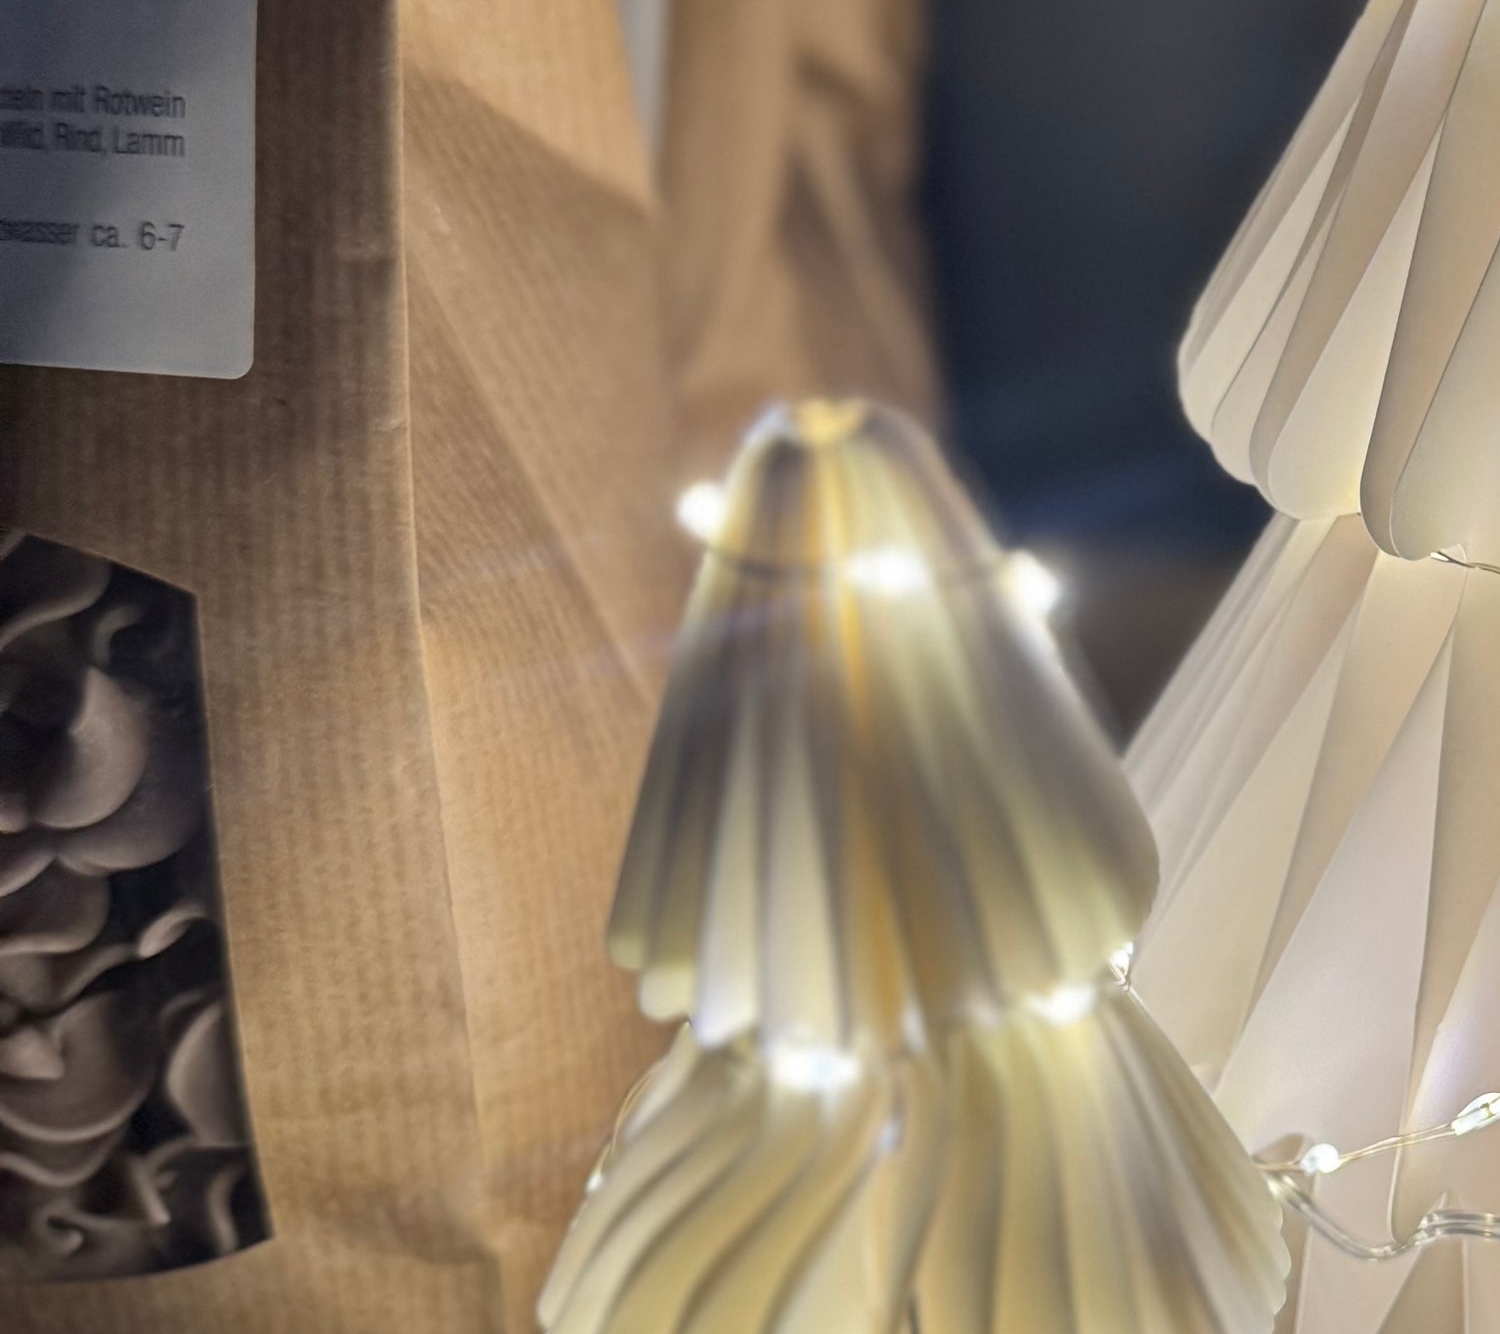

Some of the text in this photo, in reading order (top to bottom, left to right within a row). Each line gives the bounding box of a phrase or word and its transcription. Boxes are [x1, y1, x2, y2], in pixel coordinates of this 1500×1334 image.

[93, 85, 186, 118] Rotwein
[112, 125, 185, 158] Lamm
[91, 224, 127, 248] ca.
[140, 220, 185, 251] 6-7
